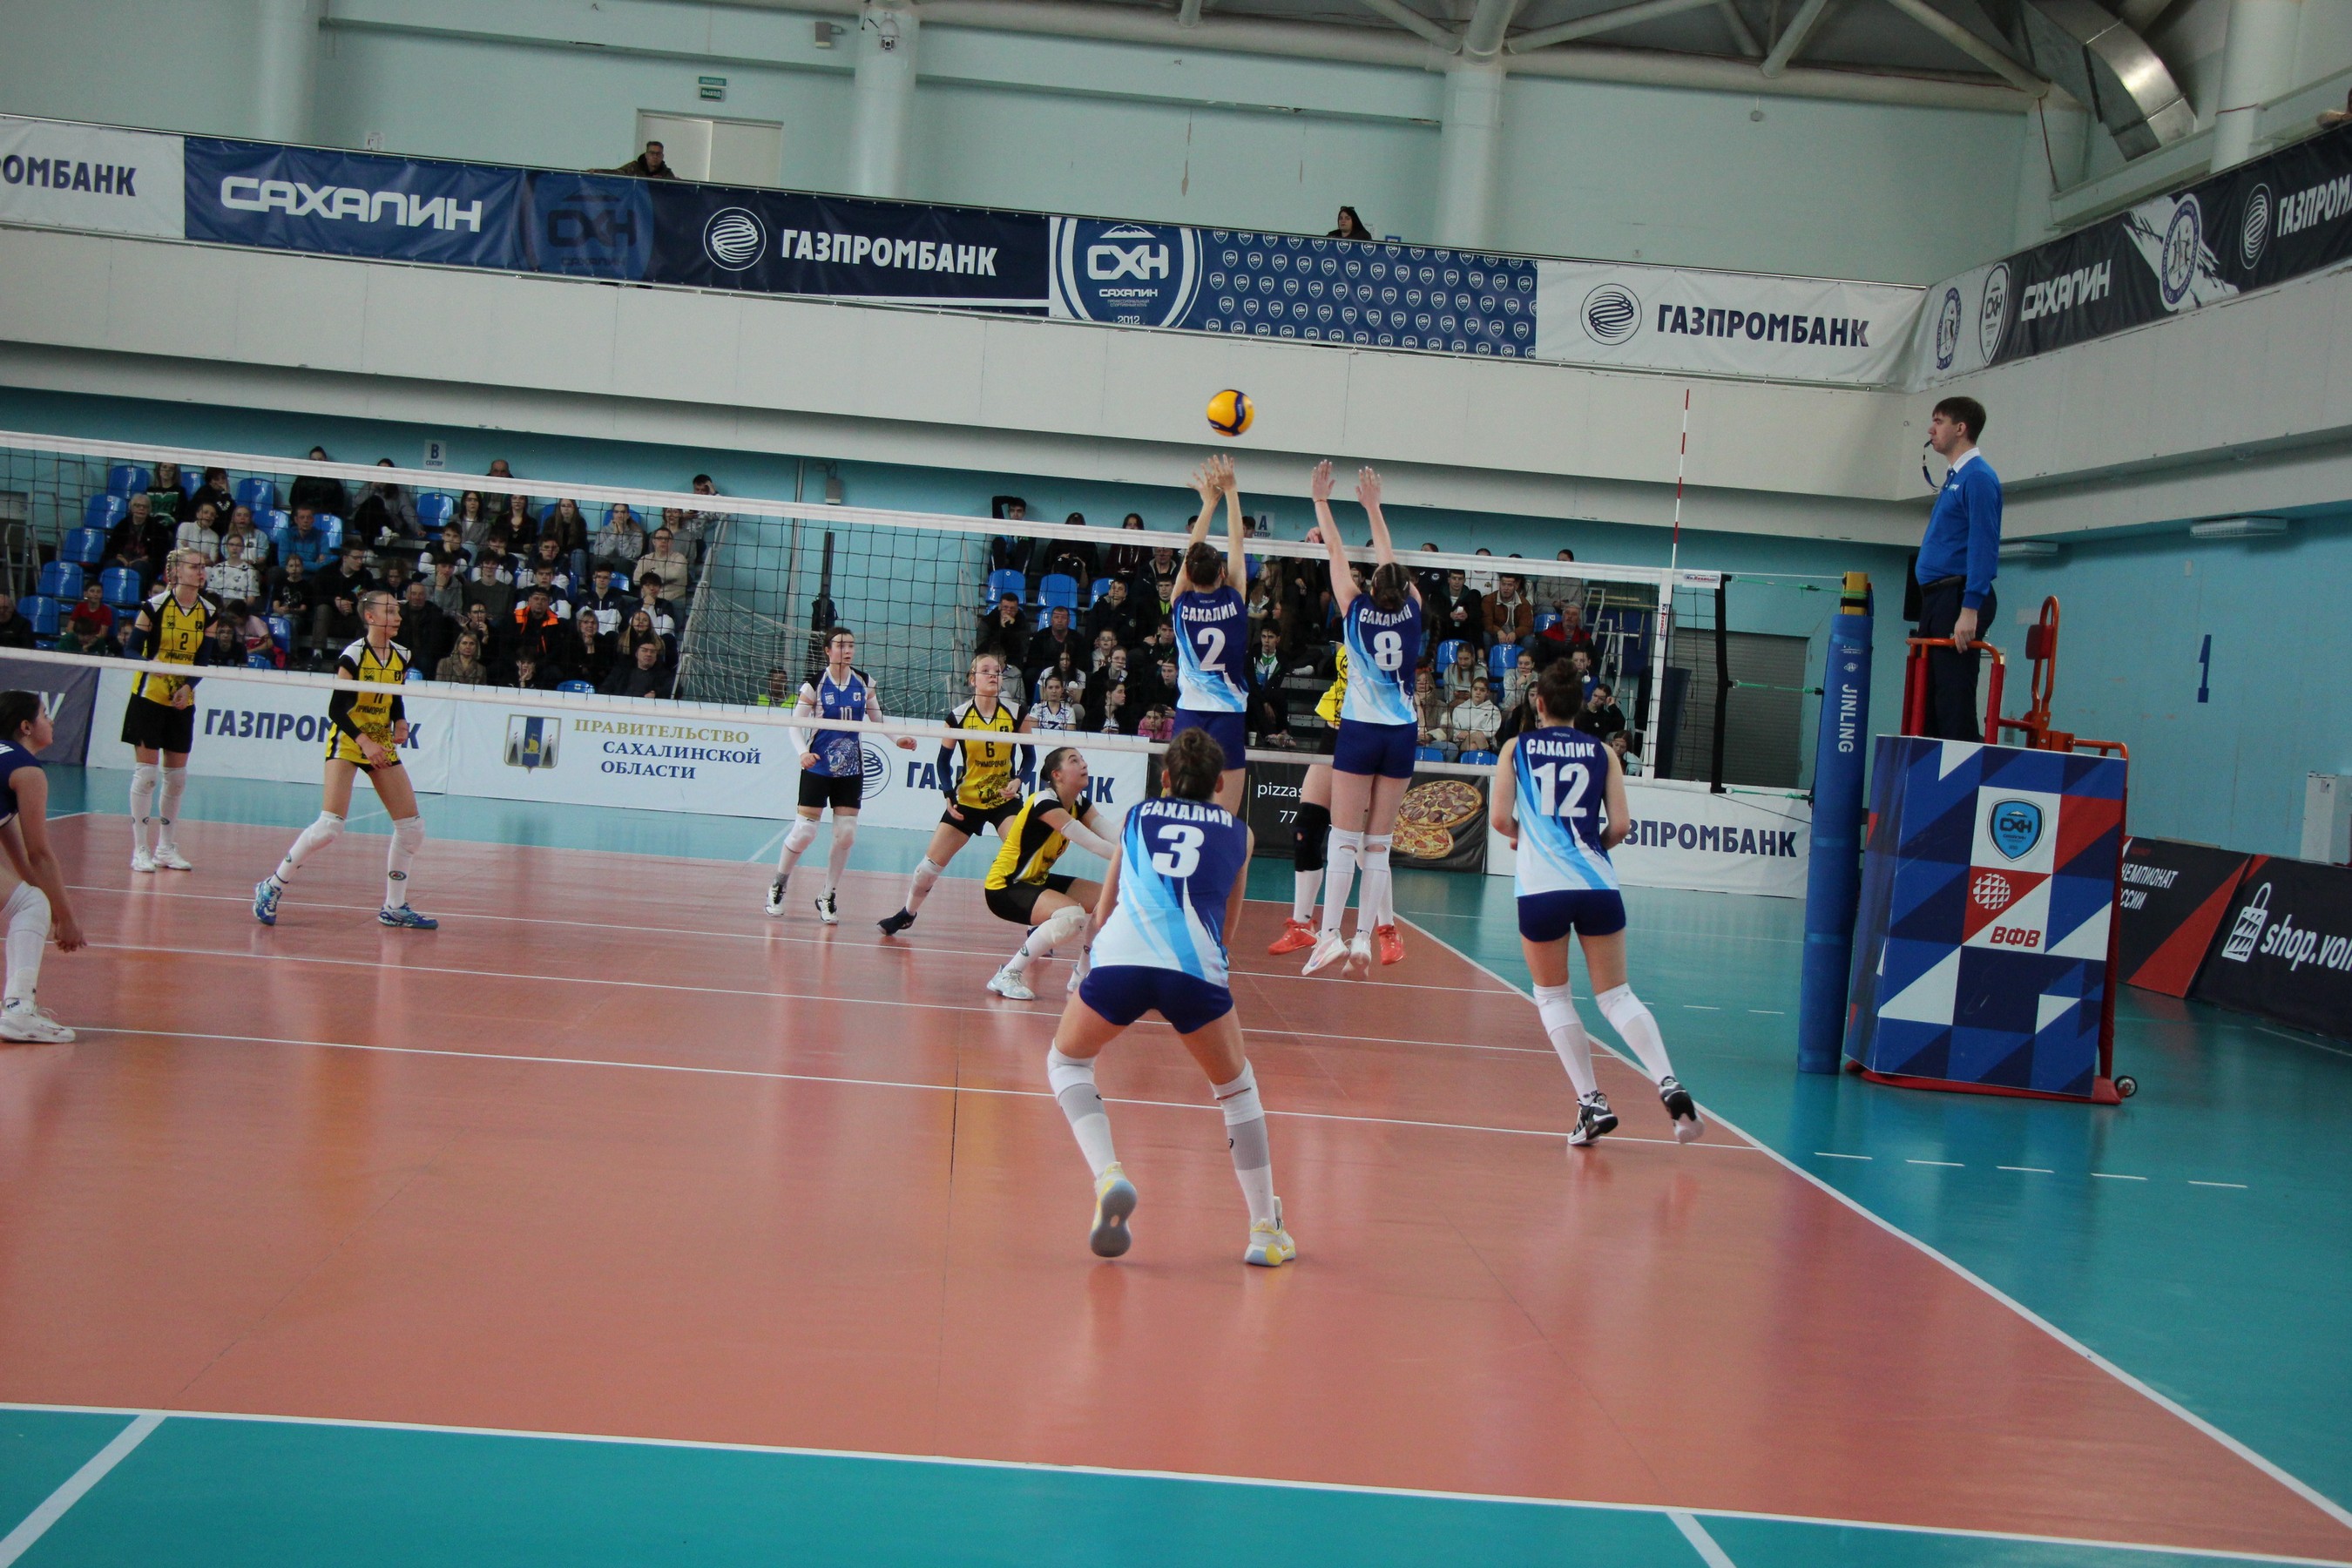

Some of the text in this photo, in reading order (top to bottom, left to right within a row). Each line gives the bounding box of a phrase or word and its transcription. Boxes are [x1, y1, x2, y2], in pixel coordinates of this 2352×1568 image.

[0, 154, 137, 197] ОМБАНК
[220, 176, 482, 233] САХАЛИН
[781, 229, 997, 276] ГАЗПРОМБАНК
[1099, 288, 1158, 297] САХАЛИН
[2021, 260, 2111, 321] САХАЛИН
[1118, 315, 1140, 325] 2012
[1657, 304, 1869, 347] ГАЗПРОМБАНК
[1181, 601, 1238, 622] САХАЛИН
[179, 632, 189, 651] 2
[1197, 627, 1226, 671] 2
[1374, 631, 1402, 672] 8
[205, 708, 422, 749] ГАЗПРОМК
[574, 719, 750, 744] ПРАВИТЕЛЬСТВО
[1838, 684, 1857, 753] JINLING
[603, 740, 761, 774] САХАЛИНСКОЙ
[985, 741, 995, 758] 6
[601, 760, 696, 780] ОБЛАСТИ
[1532, 762, 1588, 817] 12
[1140, 801, 1233, 828] САХАЛИН
[1152, 824, 1205, 878] 3
[1597, 817, 1796, 857] ГЗПРОМБАНК
[1990, 926, 2041, 948] ВФВ
